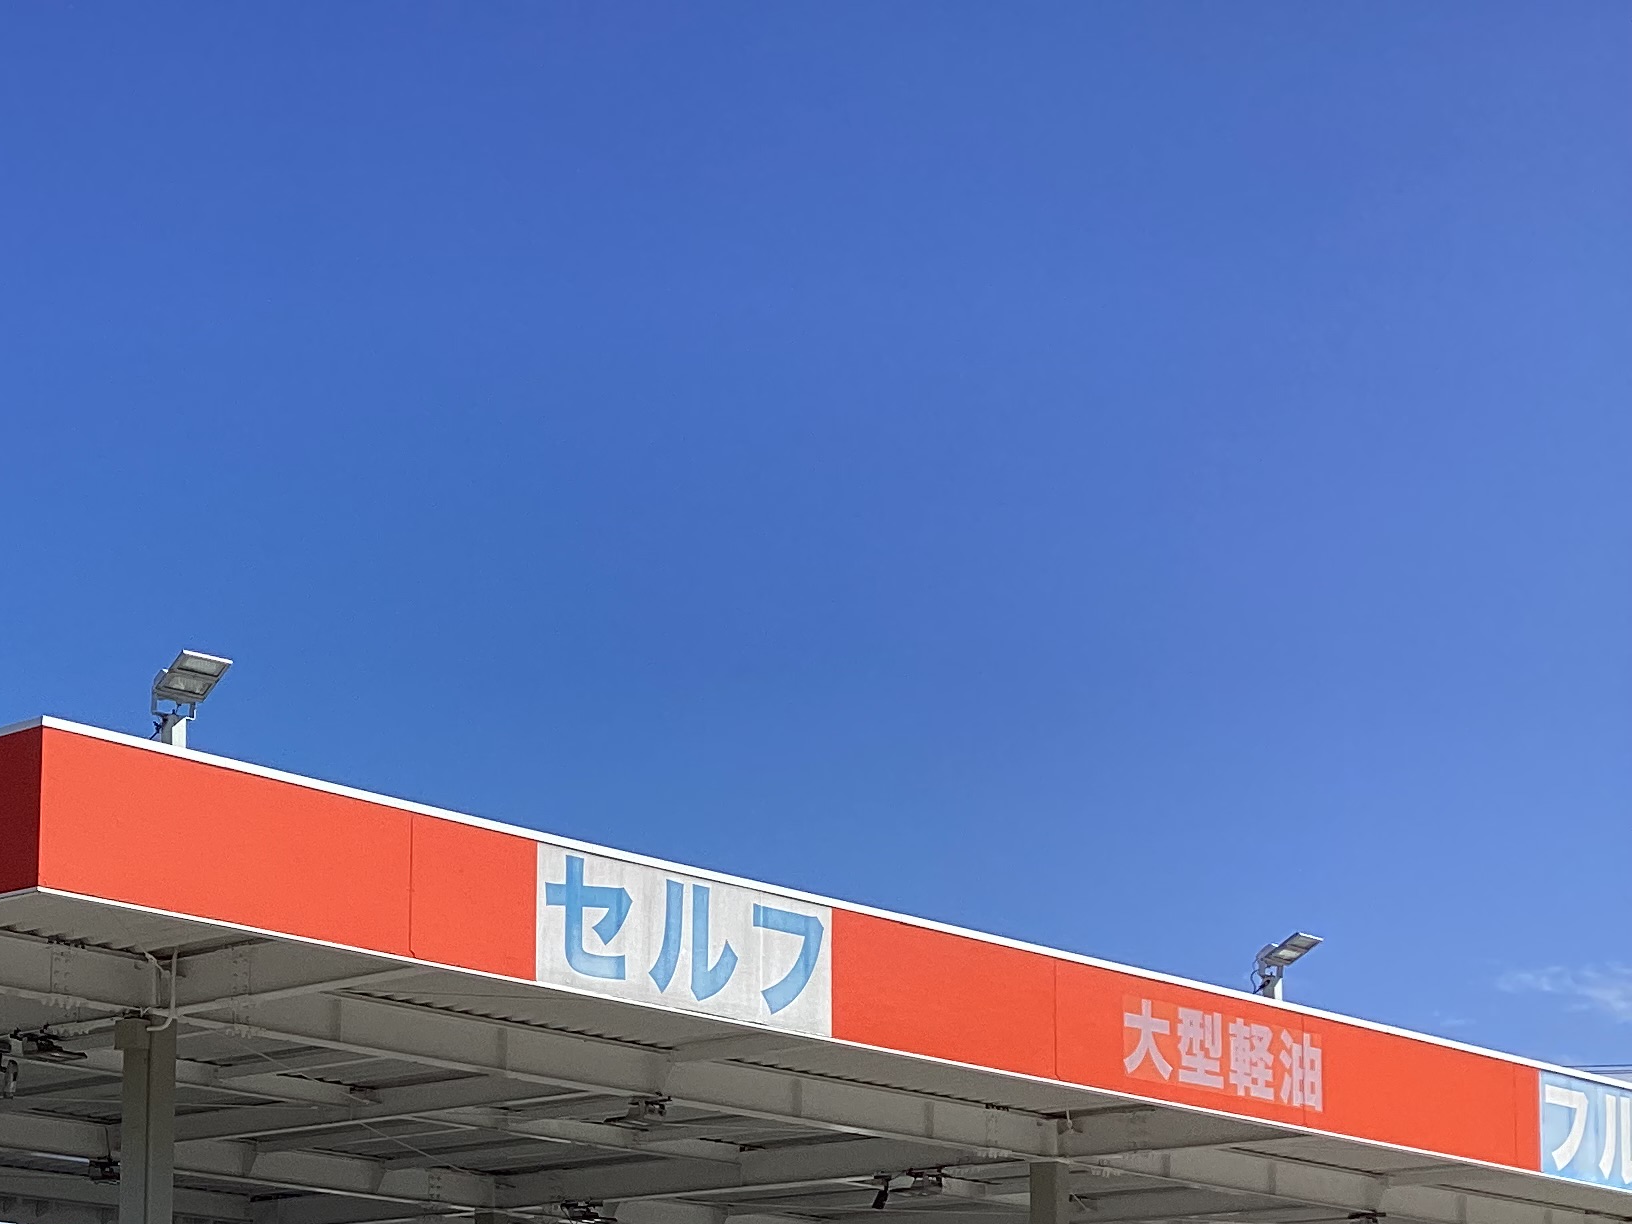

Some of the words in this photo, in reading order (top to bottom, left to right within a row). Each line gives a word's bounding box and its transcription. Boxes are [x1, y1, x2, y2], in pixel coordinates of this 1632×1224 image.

[545, 854, 824, 1015] セルフ
[1123, 998, 1323, 1112] 大型軽油
[1545, 1083, 1632, 1185] フル
